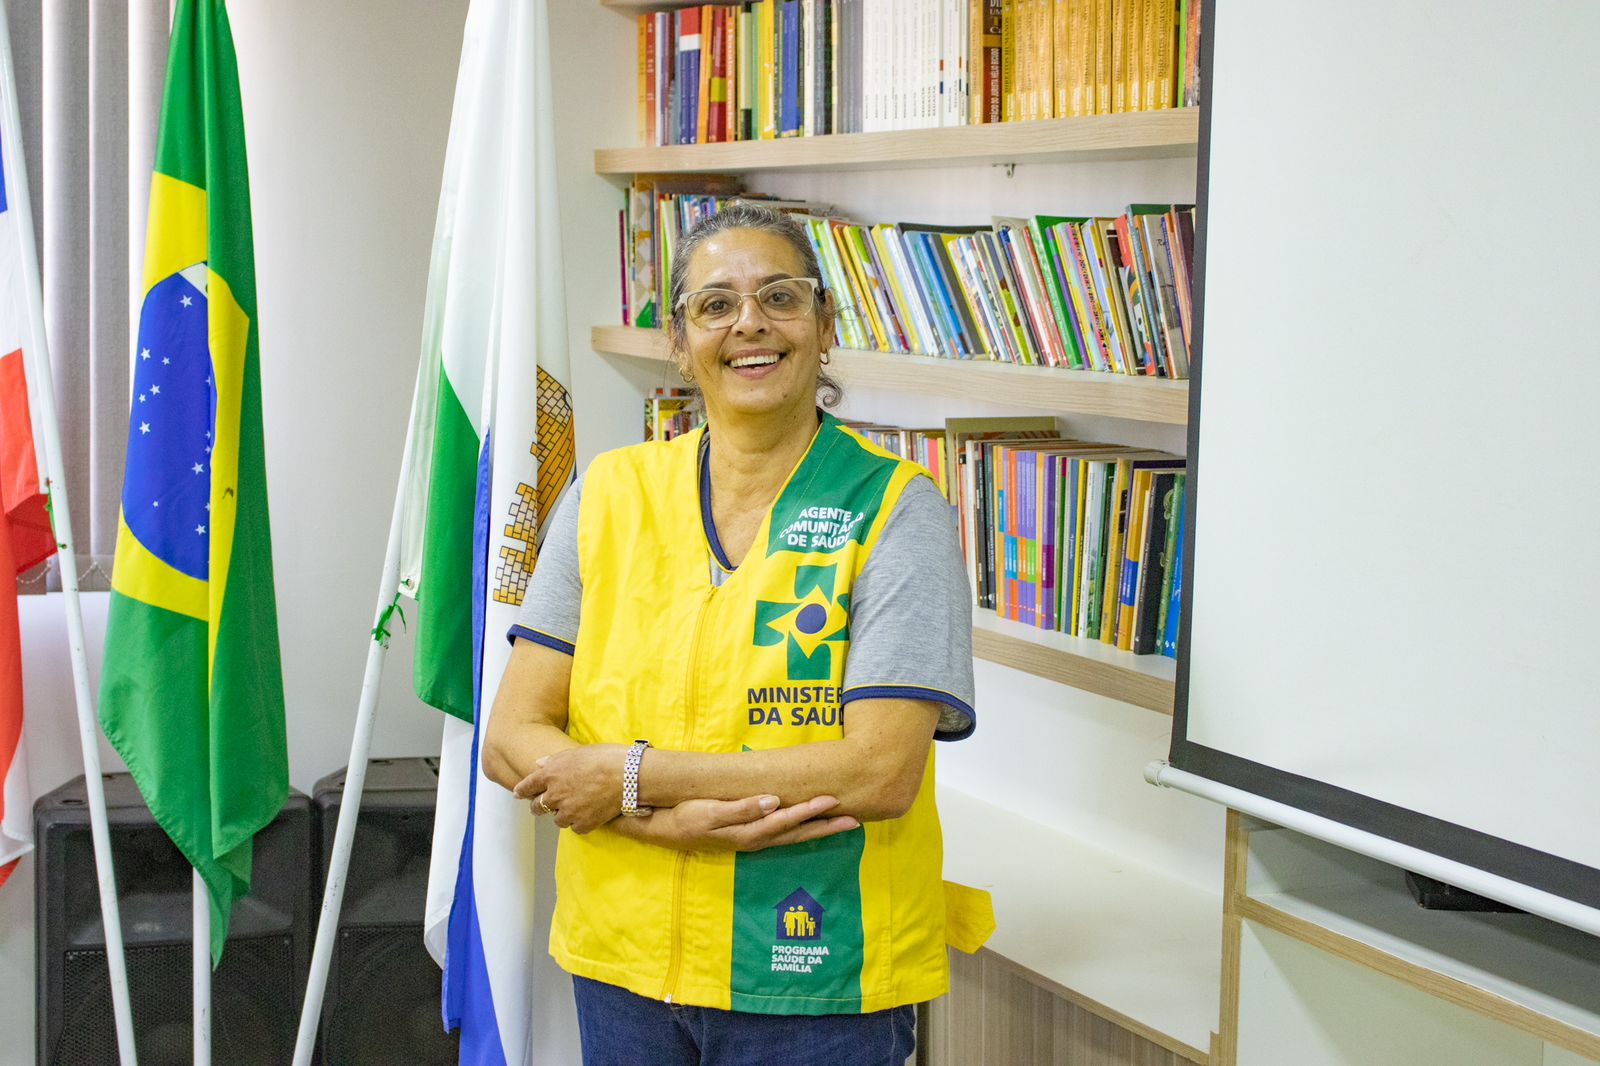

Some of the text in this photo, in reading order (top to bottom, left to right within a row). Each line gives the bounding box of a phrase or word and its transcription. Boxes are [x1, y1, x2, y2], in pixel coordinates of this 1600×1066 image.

[799, 507, 852, 522] AGENTE
[788, 531, 850, 548] DE SAÚD
[749, 707, 783, 726] DA
[772, 945, 829, 955] PROGRAMA
[807, 956, 823, 965] DA
[771, 963, 812, 973] FAMÍLIA
